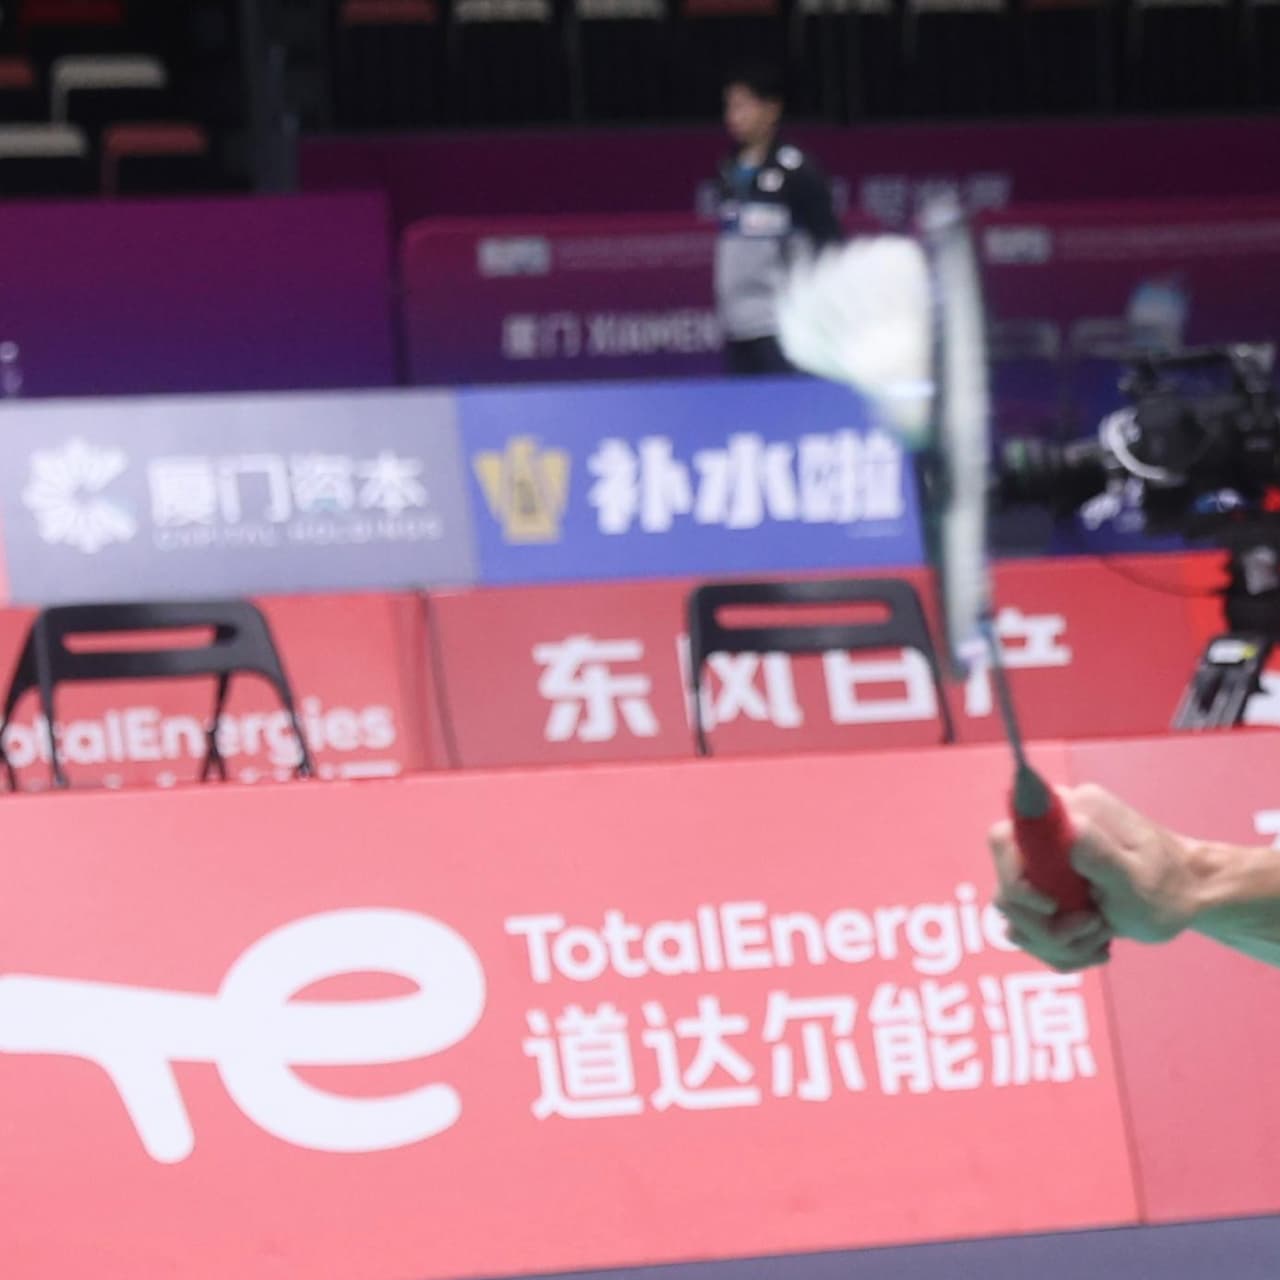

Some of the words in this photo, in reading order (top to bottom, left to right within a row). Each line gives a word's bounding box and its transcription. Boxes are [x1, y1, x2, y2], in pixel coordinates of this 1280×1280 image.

[148, 449, 430, 528] 厦门资本
[587, 426, 904, 534] 补水啦
[0, 697, 397, 770] otalEnergies
[522, 969, 1098, 1121] 道达尔能源
